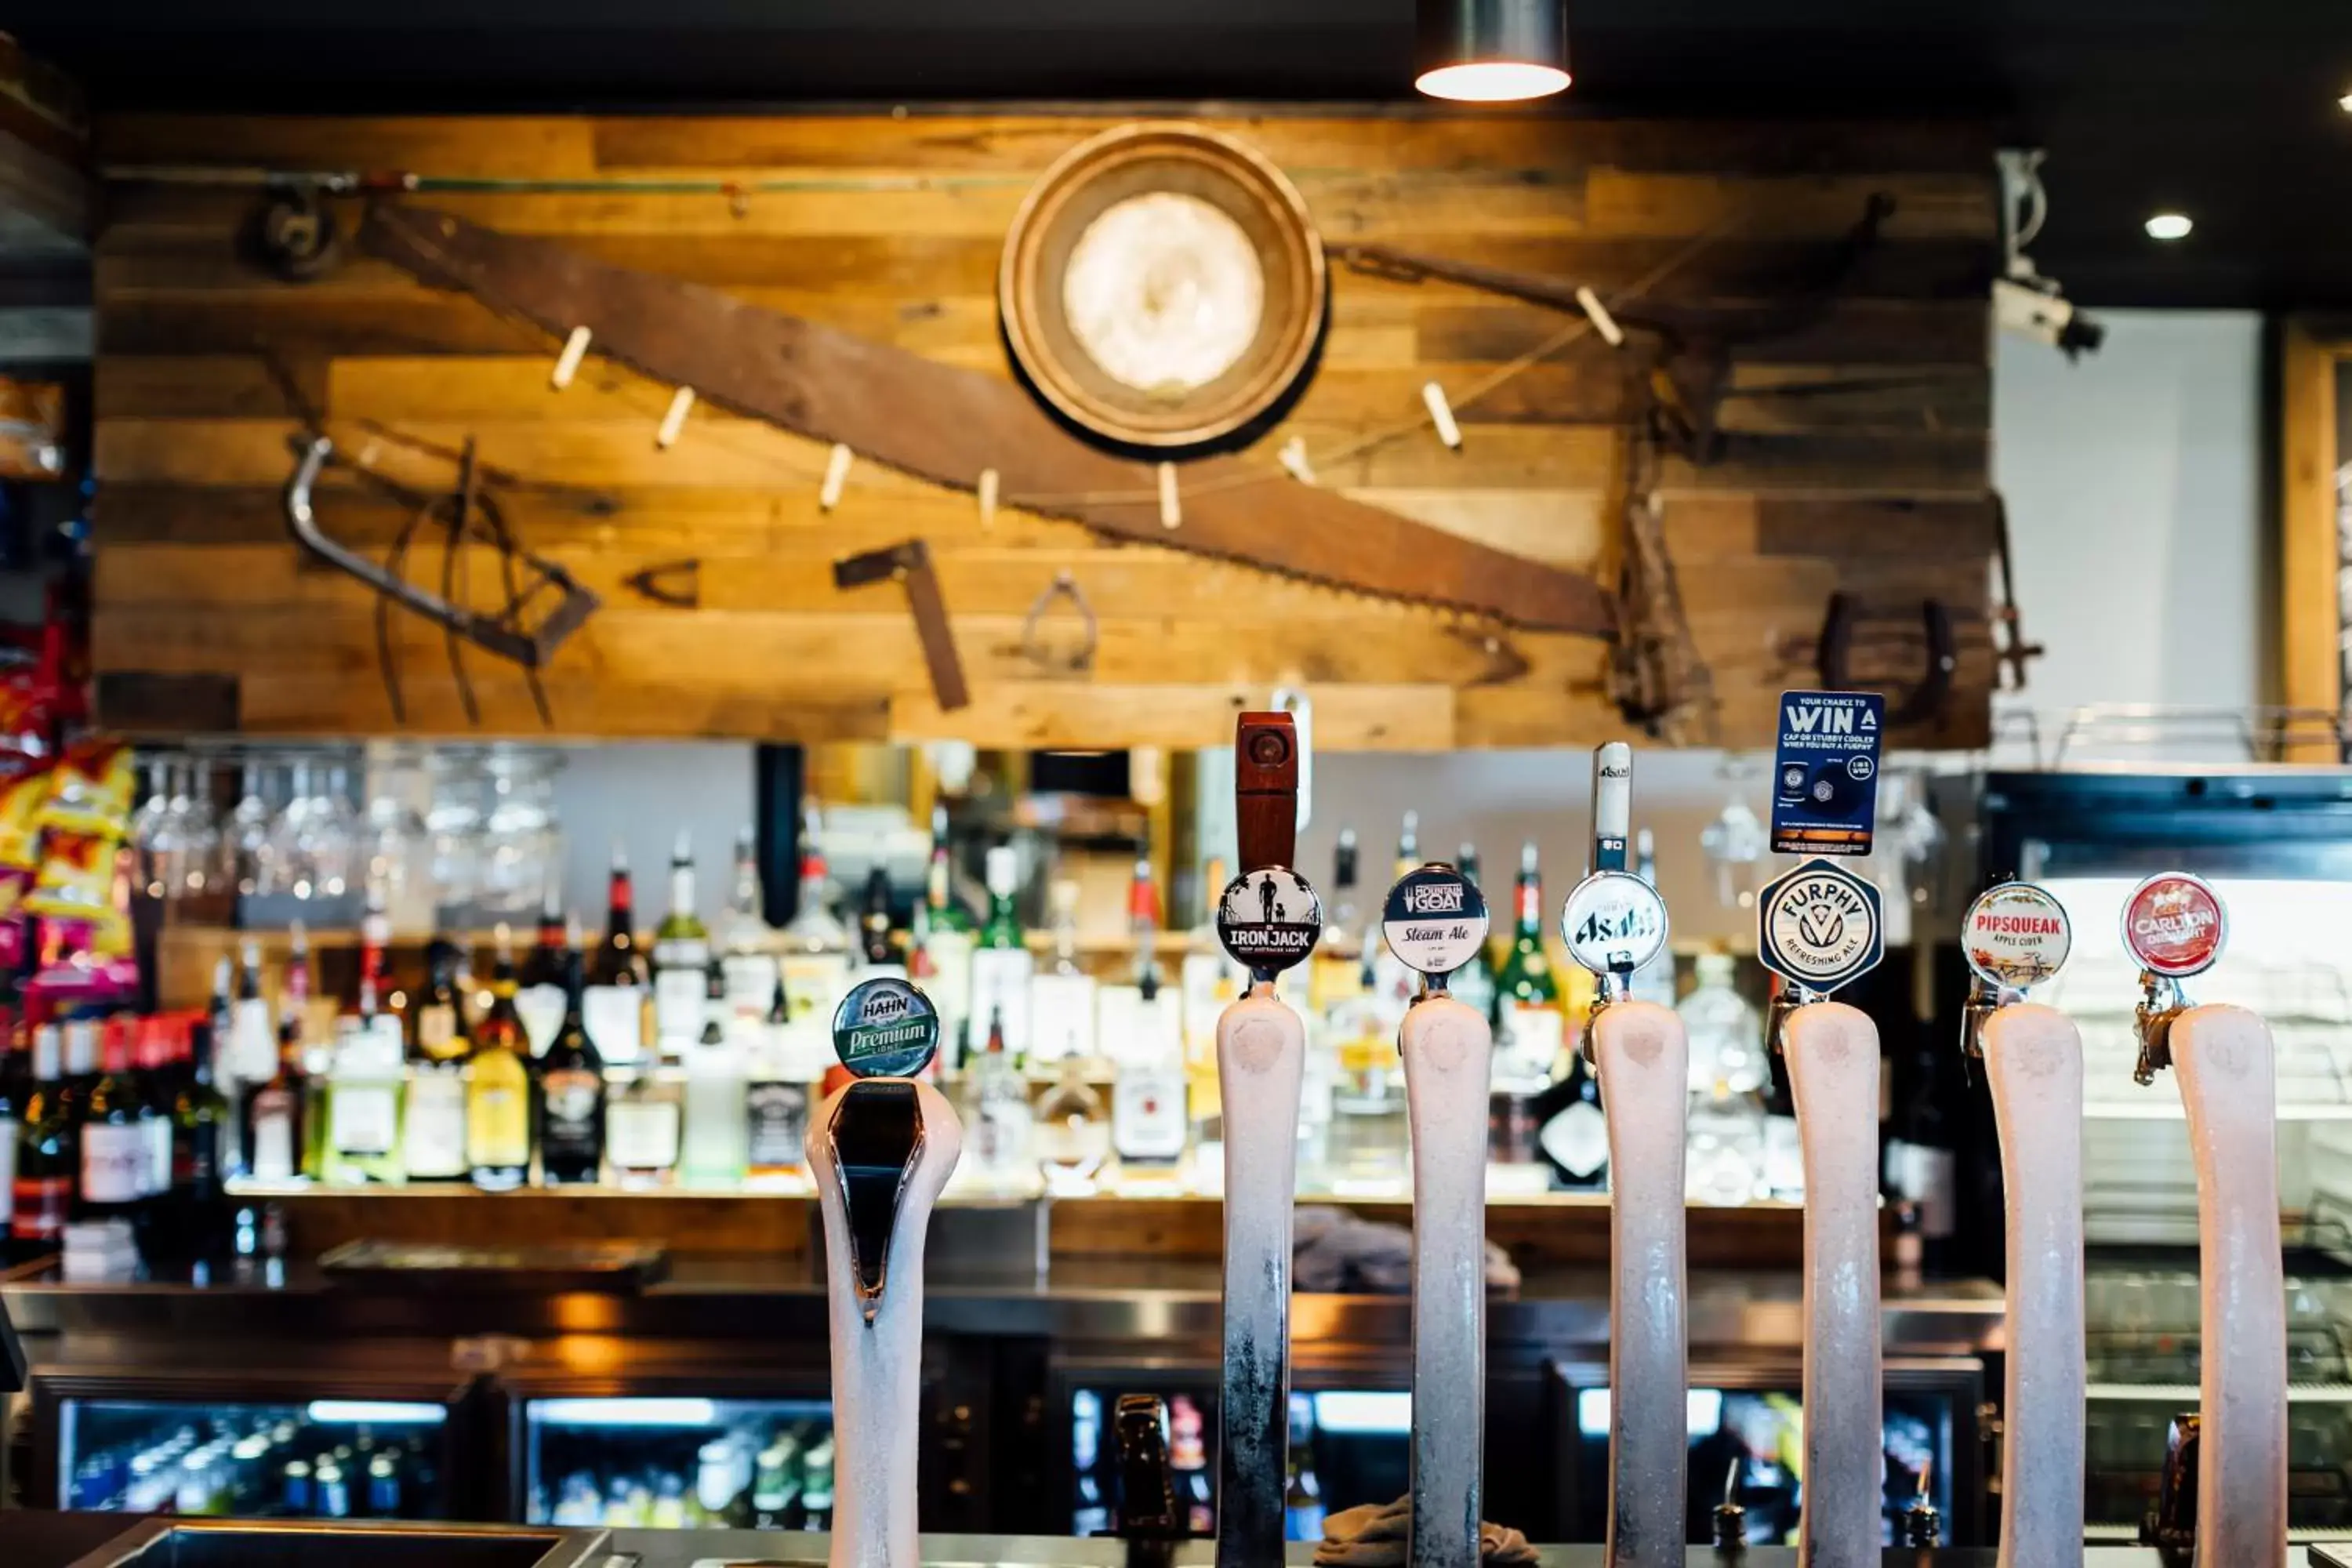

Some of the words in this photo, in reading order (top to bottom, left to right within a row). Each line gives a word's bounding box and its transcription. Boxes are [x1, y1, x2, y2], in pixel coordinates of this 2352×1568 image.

[1822, 698, 1853, 706] CHANCE
[1786, 706, 1854, 734] WIN
[1860, 708, 1876, 724] A
[1843, 735, 1875, 743] COOLER
[1415, 885, 1464, 897] MOUNTAIN
[1415, 894, 1464, 910] GOAT
[1781, 884, 1863, 918] FURPHY
[1976, 915, 2061, 935] PIPSQUEAK
[2136, 909, 2214, 935] CARLTON
[1230, 930, 1269, 946] IRON
[1270, 931, 1309, 947] JACK
[1402, 927, 1444, 942] Steam
[1448, 925, 1468, 940] Ale
[1994, 934, 2016, 946] APPLE
[2019, 935, 2043, 946] CIDER
[1786, 938, 1842, 966] REFRESHING
[1843, 938, 1858, 958] ALE
[863, 996, 908, 1018] HAHN
[849, 1024, 926, 1054] Premium
